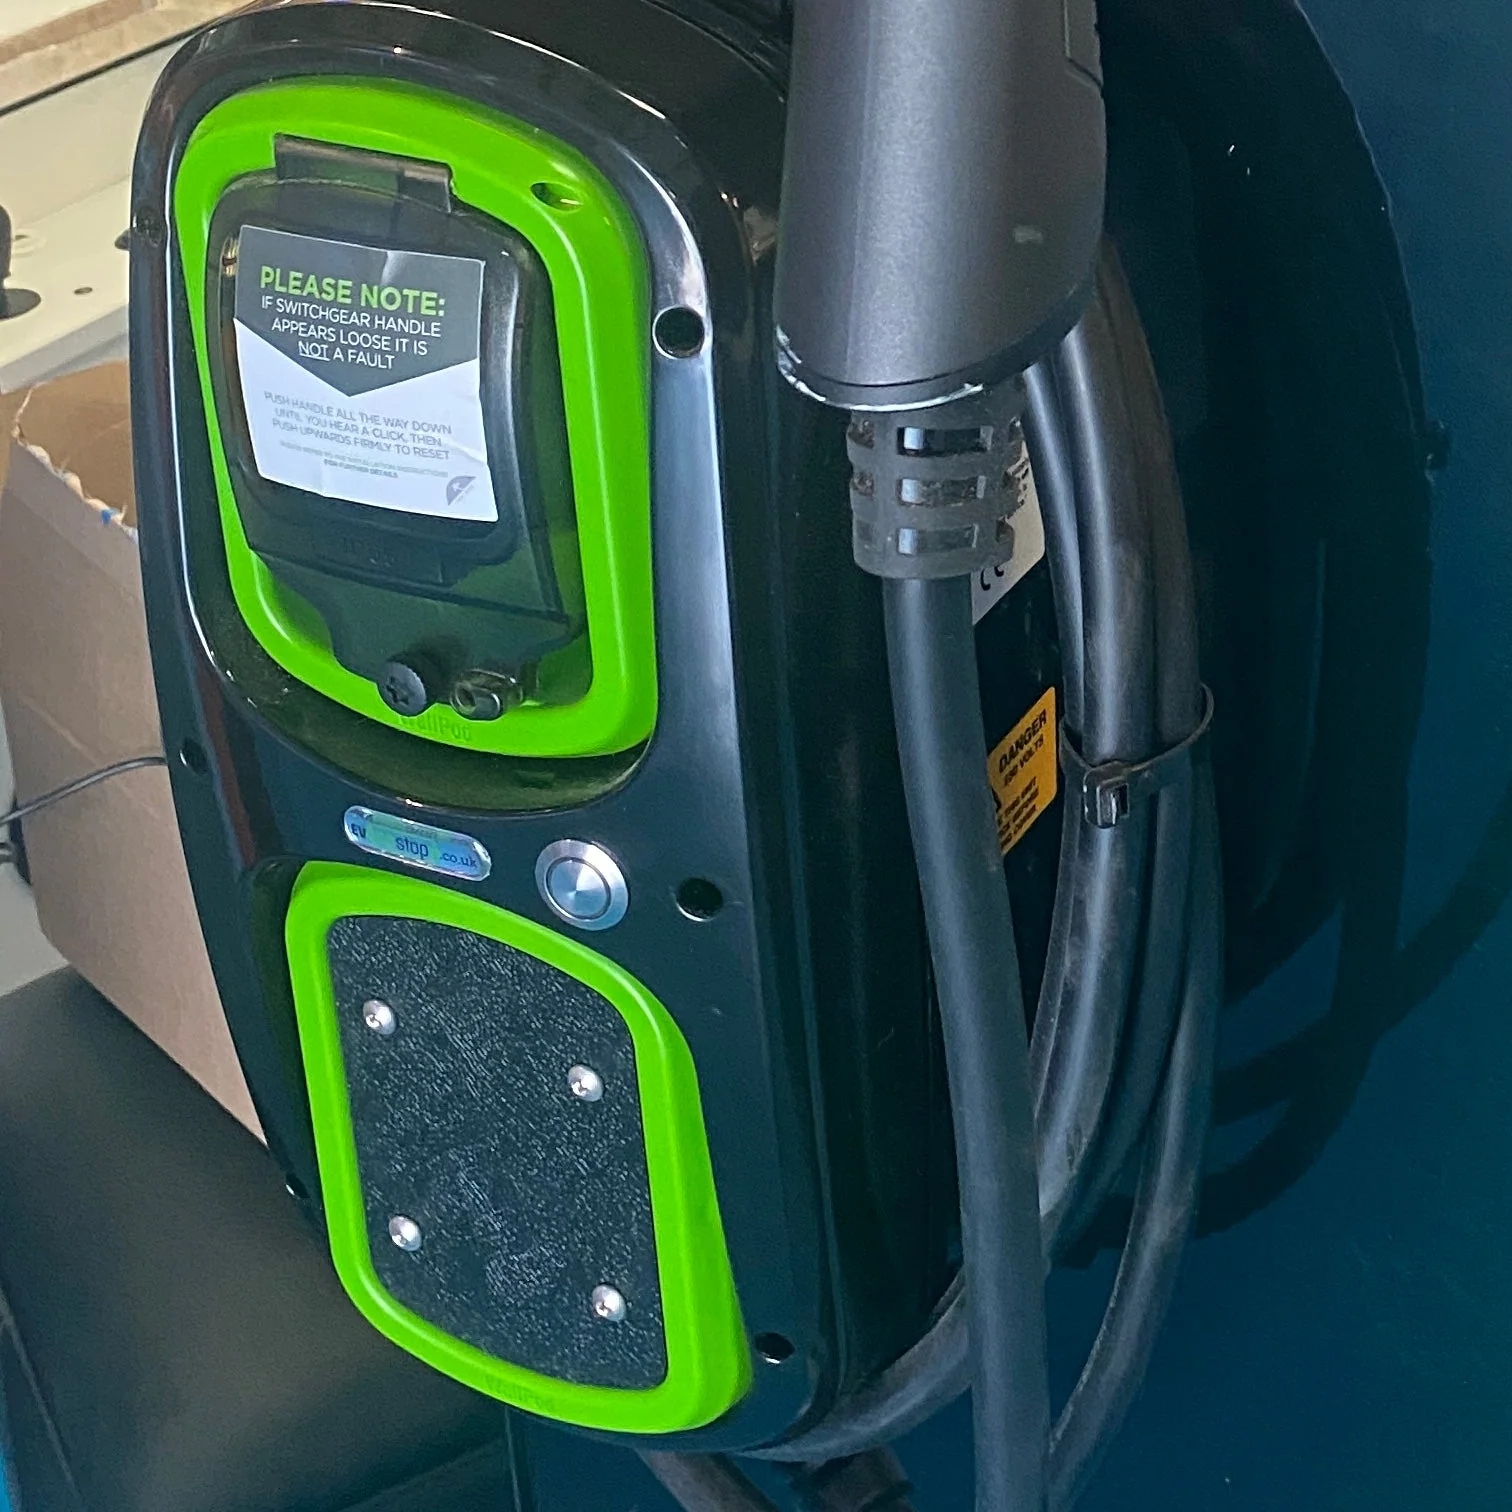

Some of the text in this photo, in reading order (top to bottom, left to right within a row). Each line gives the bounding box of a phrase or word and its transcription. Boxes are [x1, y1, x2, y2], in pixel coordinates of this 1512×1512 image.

[260, 265, 446, 317] PLEASE NOTE:
[261, 295, 442, 338] IF SWITCHGEAR HANDLE
[271, 317, 428, 356] APPEARS LOOSE IT IS
[298, 340, 395, 369] NOT A FAULT
[264, 390, 452, 435] PUSH HANDLE ALL THE WAY DOWN
[274, 407, 303, 422] UNTIL
[304, 414, 327, 429] YOU
[329, 419, 359, 434] HEAR
[361, 423, 370, 435] A
[410, 432, 442, 448] THEN
[271, 417, 298, 434] PUSH
[300, 425, 351, 446] UPWARDS
[353, 436, 392, 452] FIRMLY
[395, 442, 411, 456] TO
[413, 446, 450, 461] RESET
[999, 708, 1047, 773] DANGER
[395, 836, 429, 861] stop
